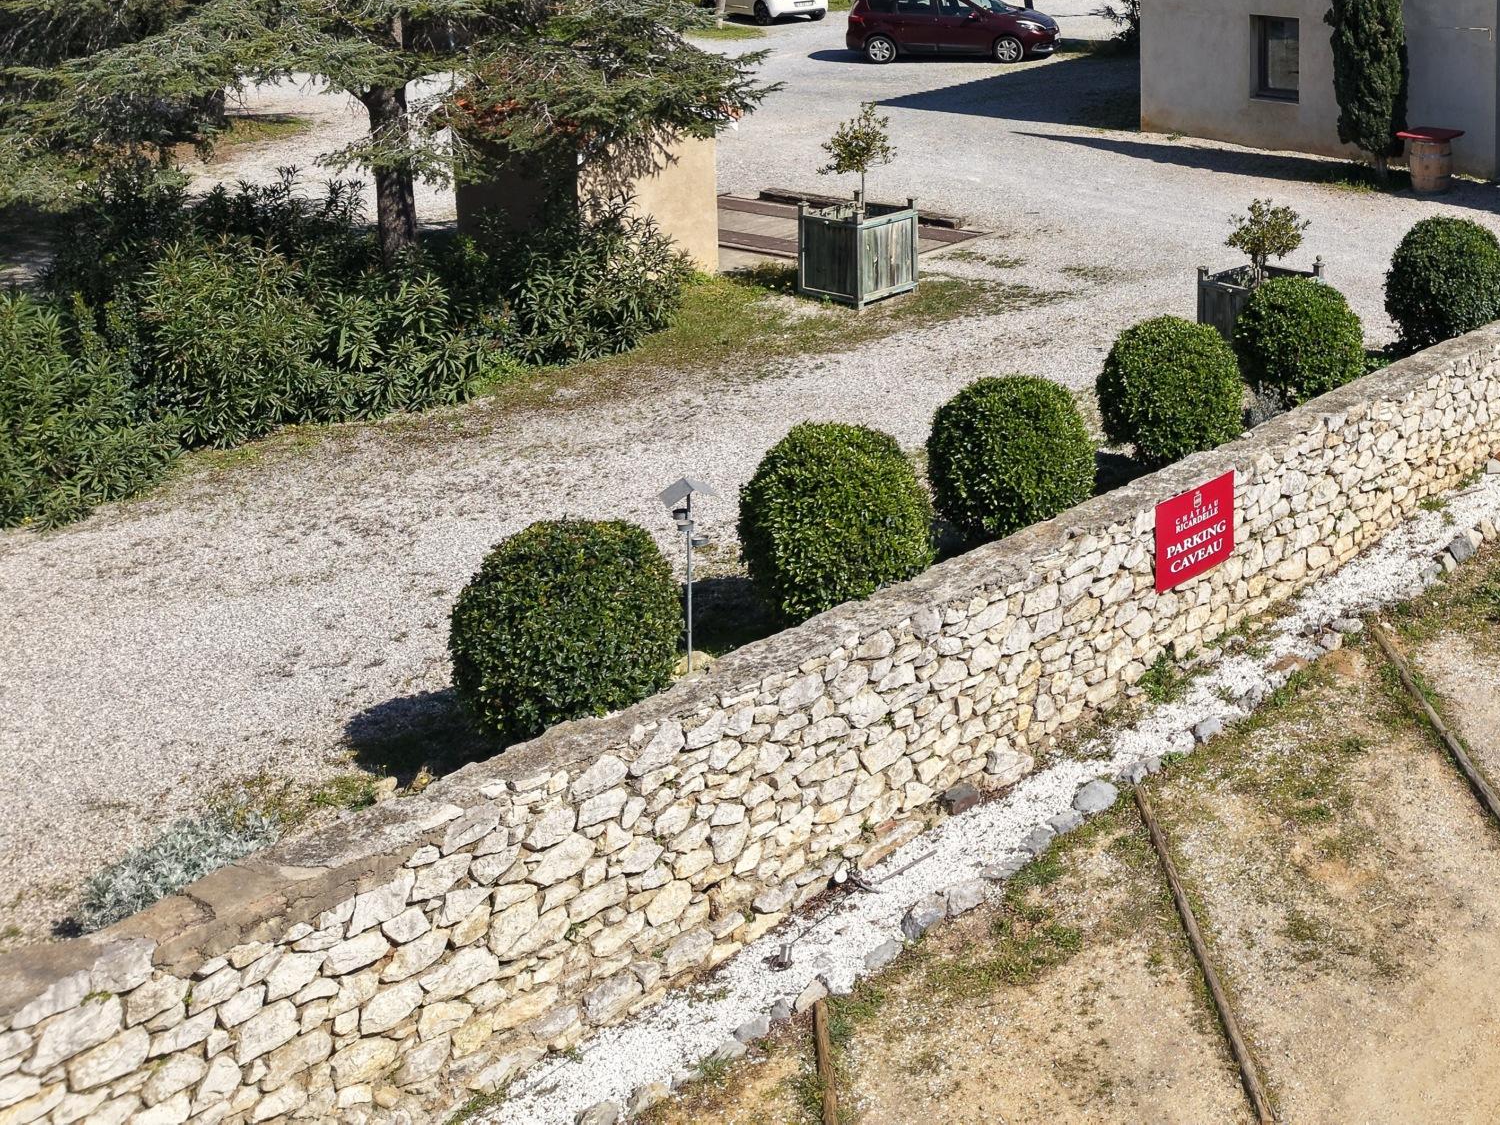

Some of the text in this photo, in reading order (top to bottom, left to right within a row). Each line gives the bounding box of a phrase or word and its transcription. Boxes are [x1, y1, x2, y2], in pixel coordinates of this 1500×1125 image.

[1175, 507, 1219, 534] RICARDELLE
[1166, 520, 1226, 559] PARKING
[1170, 538, 1223, 572] CAVEAU
